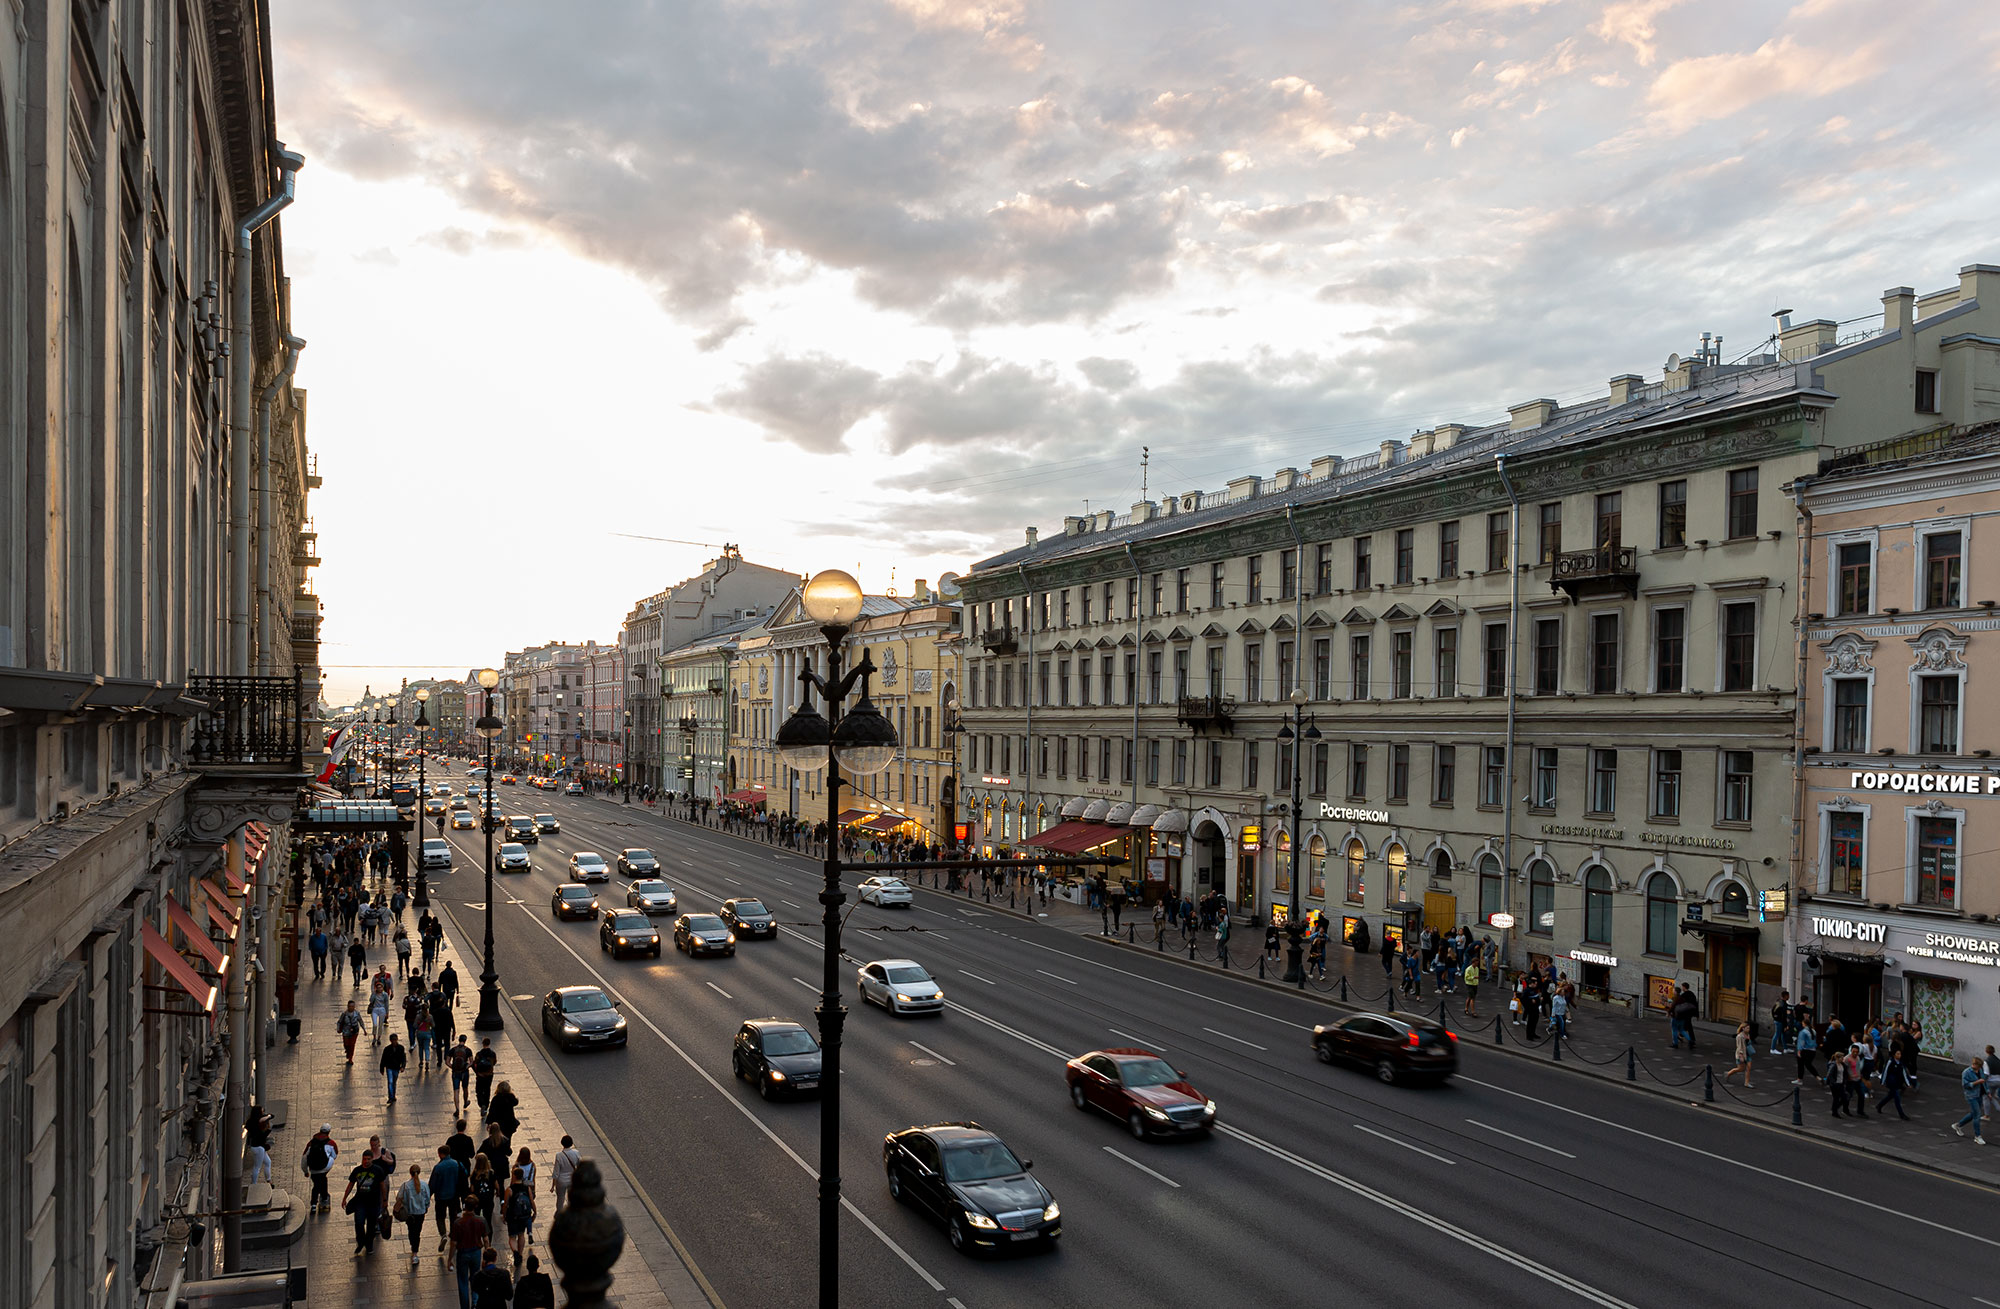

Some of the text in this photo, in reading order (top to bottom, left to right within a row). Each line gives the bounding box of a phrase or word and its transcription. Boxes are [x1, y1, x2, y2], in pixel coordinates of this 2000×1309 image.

[1851, 772, 1980, 793] ГОРОДСКИЕ
[1320, 802, 1389, 823] Ростелеком
[1925, 933, 2000, 955] SHOWBAR
[1569, 949, 1618, 967] СТОЛОВАЯ
[1935, 949, 1994, 966] НАСТОЛЬНЫХ
